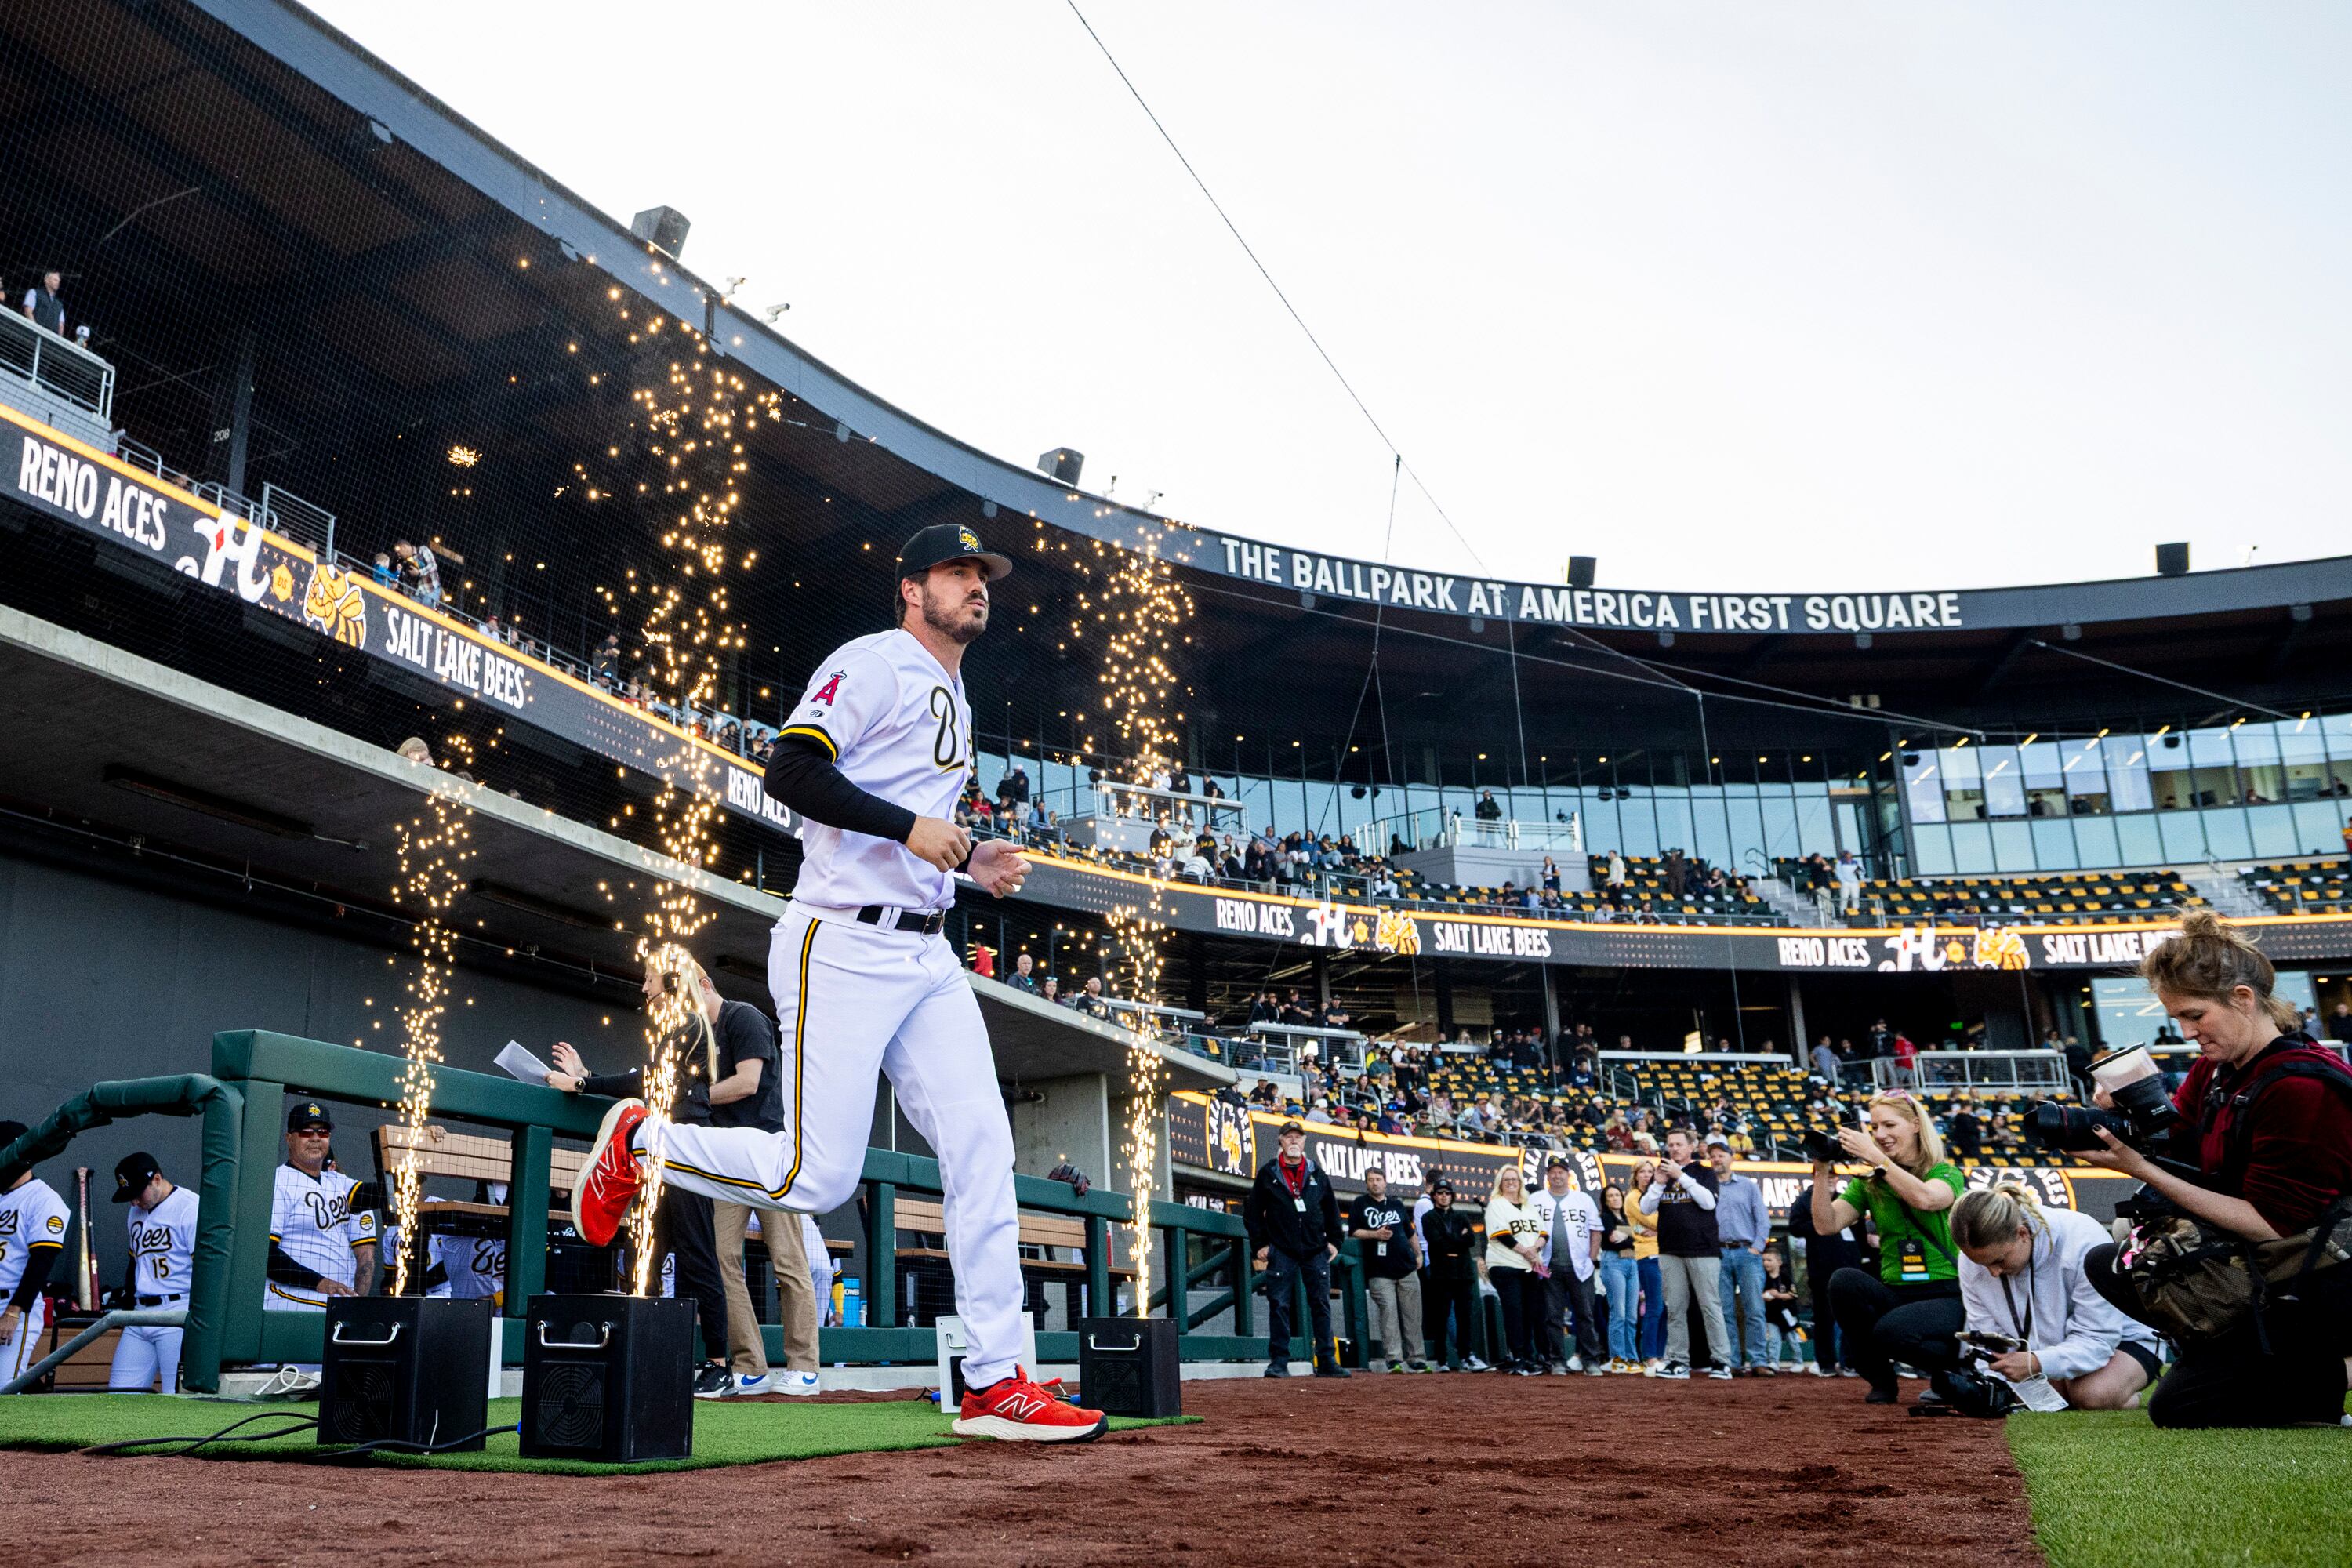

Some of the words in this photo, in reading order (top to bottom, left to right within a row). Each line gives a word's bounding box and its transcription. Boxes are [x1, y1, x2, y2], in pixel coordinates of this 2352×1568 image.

[18, 436, 98, 519] RENO
[100, 476, 167, 551] ACES
[1221, 537, 1283, 583] THE
[1292, 553, 1458, 612] BALLPARK
[1468, 583, 1506, 616] AT
[1519, 586, 1679, 628] AMERICA
[1689, 596, 1791, 630] FIRST
[1805, 593, 1962, 631] SQUARE
[386, 608, 433, 669] SALT
[434, 629, 481, 691] LAKE
[483, 652, 524, 709] BEES
[810, 672, 838, 706] A
[728, 765, 761, 815] RENO
[1216, 898, 1256, 932] RENO
[1259, 904, 1294, 937] ACES
[1433, 922, 1470, 953] SALT
[1472, 924, 1512, 955] LAKE
[1513, 927, 1552, 957] BEES
[1777, 938, 1824, 967] RENO
[1828, 938, 1871, 967] ACES
[2042, 935, 2087, 964] SALT
[2087, 932, 2142, 963] LAKE
[1316, 1142, 1347, 1178] SALT
[1384, 1151, 1423, 1187] BEES
[1750, 1178, 1800, 1207] AKE
[0, 1209, 19, 1235] es
[305, 1191, 350, 1232] Bees
[130, 1221, 172, 1258] Bees
[152, 1258, 169, 1279] 15
[471, 1238, 505, 1279] Be
[993, 1392, 1047, 1421] N
